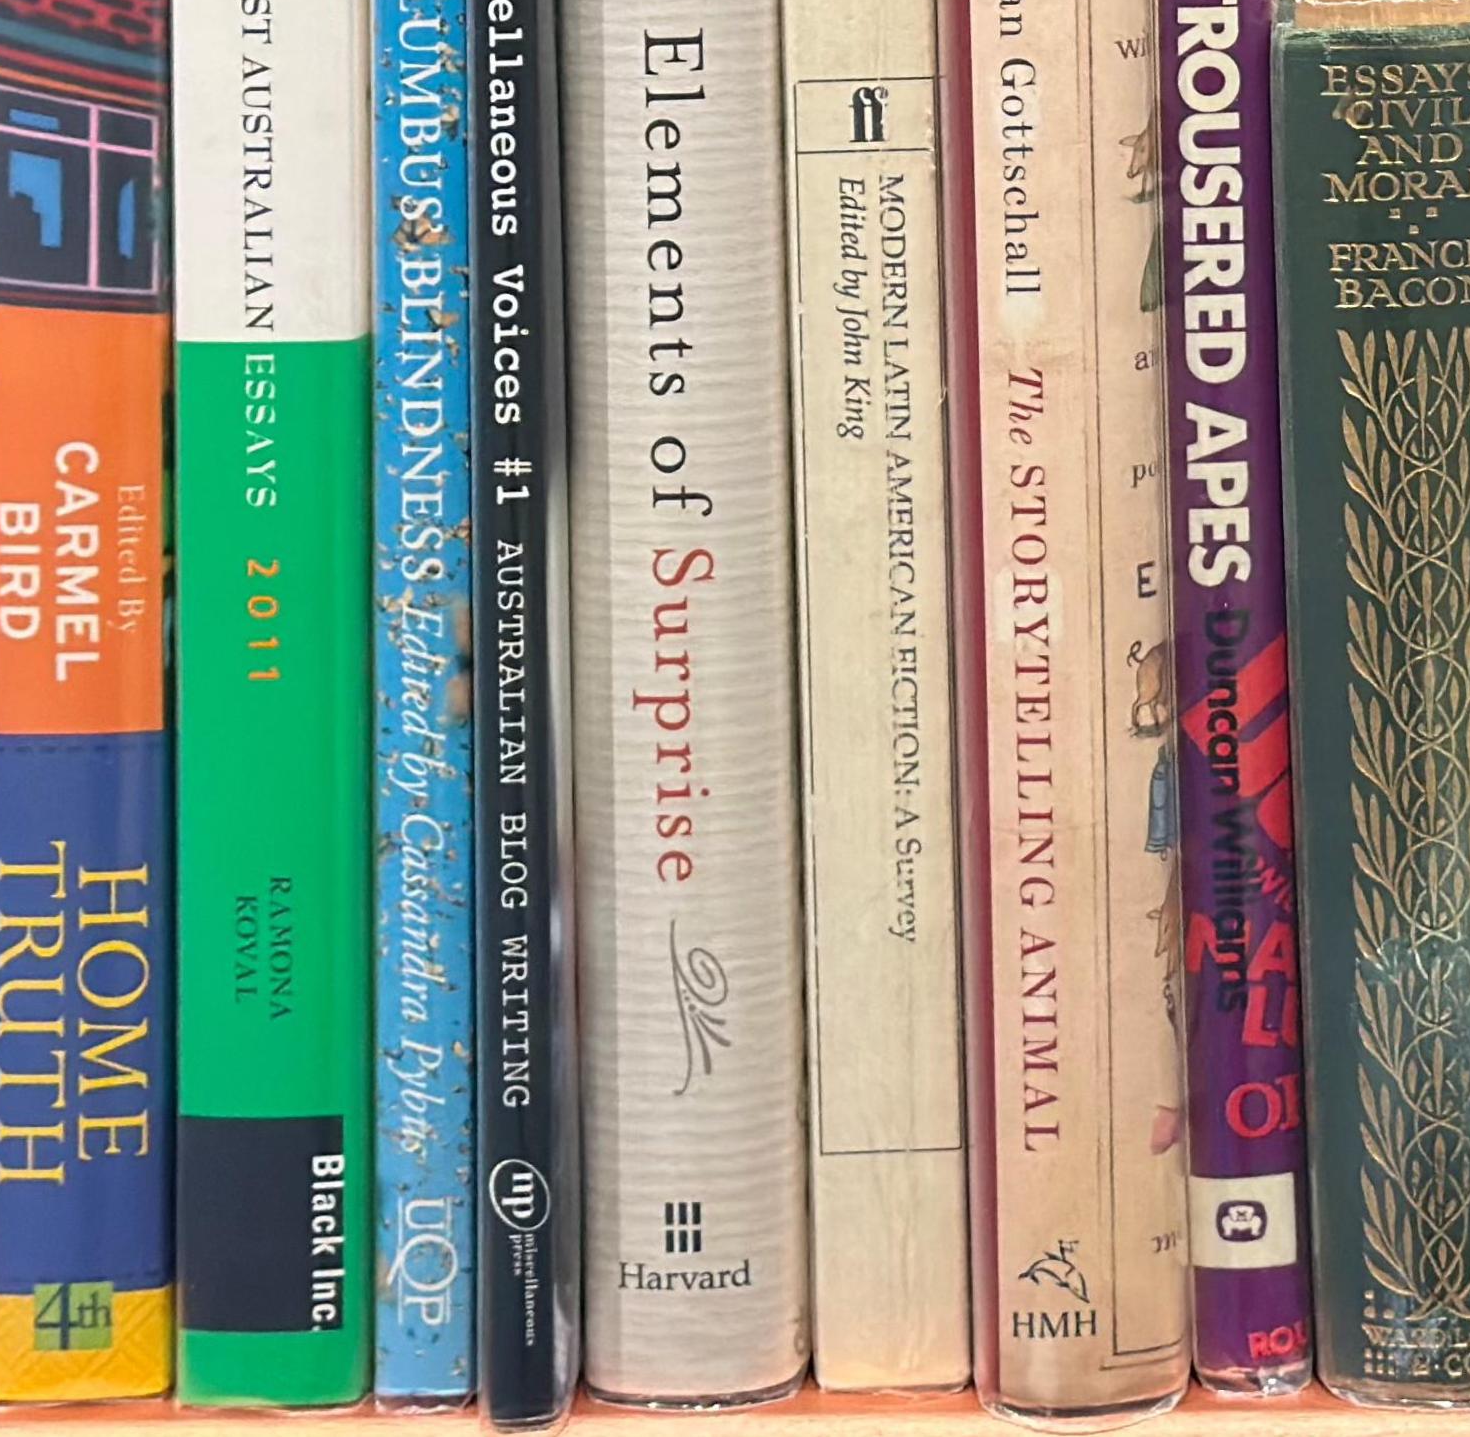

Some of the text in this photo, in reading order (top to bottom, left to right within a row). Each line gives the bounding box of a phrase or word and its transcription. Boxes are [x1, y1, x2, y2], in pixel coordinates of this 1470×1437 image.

[241, 52, 274, 331] AUSTRALIAN
[998, 57, 1041, 297] Gottschall
[1357, 133, 1464, 165] AND
[492, 264, 526, 424] Voices
[833, 177, 873, 439] Edited by John King
[245, 353, 276, 509] ESSAYS
[399, 260, 444, 581] BLINDNESS
[494, 457, 529, 504] #1
[633, 28, 715, 883] Elements of Surprise
[1186, 402, 1252, 586] APES
[53, 442, 101, 682] CARMEL
[107, 484, 147, 634] Edited By
[247, 558, 279, 683] 2011
[878, 174, 924, 943] MODERN LATIN AMERICAN FICTION: A Survey
[494, 539, 531, 1107] AUSTRALIAN BLOG WRITING
[1005, 366, 1062, 1153] The STORYTELLING ANIMAL
[1205, 612, 1258, 1009] Duncan Williams
[233, 893, 258, 1005] KOVAL
[268, 875, 293, 1020] RAMONA
[388, 602, 444, 1155] Edited by Cassandra Pybus
[76, 862, 151, 1161] HOME
[35, 1284, 112, 1350] 4th
[310, 1153, 346, 1331] Black Inc.
[388, 1198, 458, 1326] UQP
[509, 1233, 523, 1276] press
[524, 1233, 538, 1346] miscellaneous
[617, 1261, 752, 1289] Harvard
[1012, 1310, 1097, 1338] HMH
